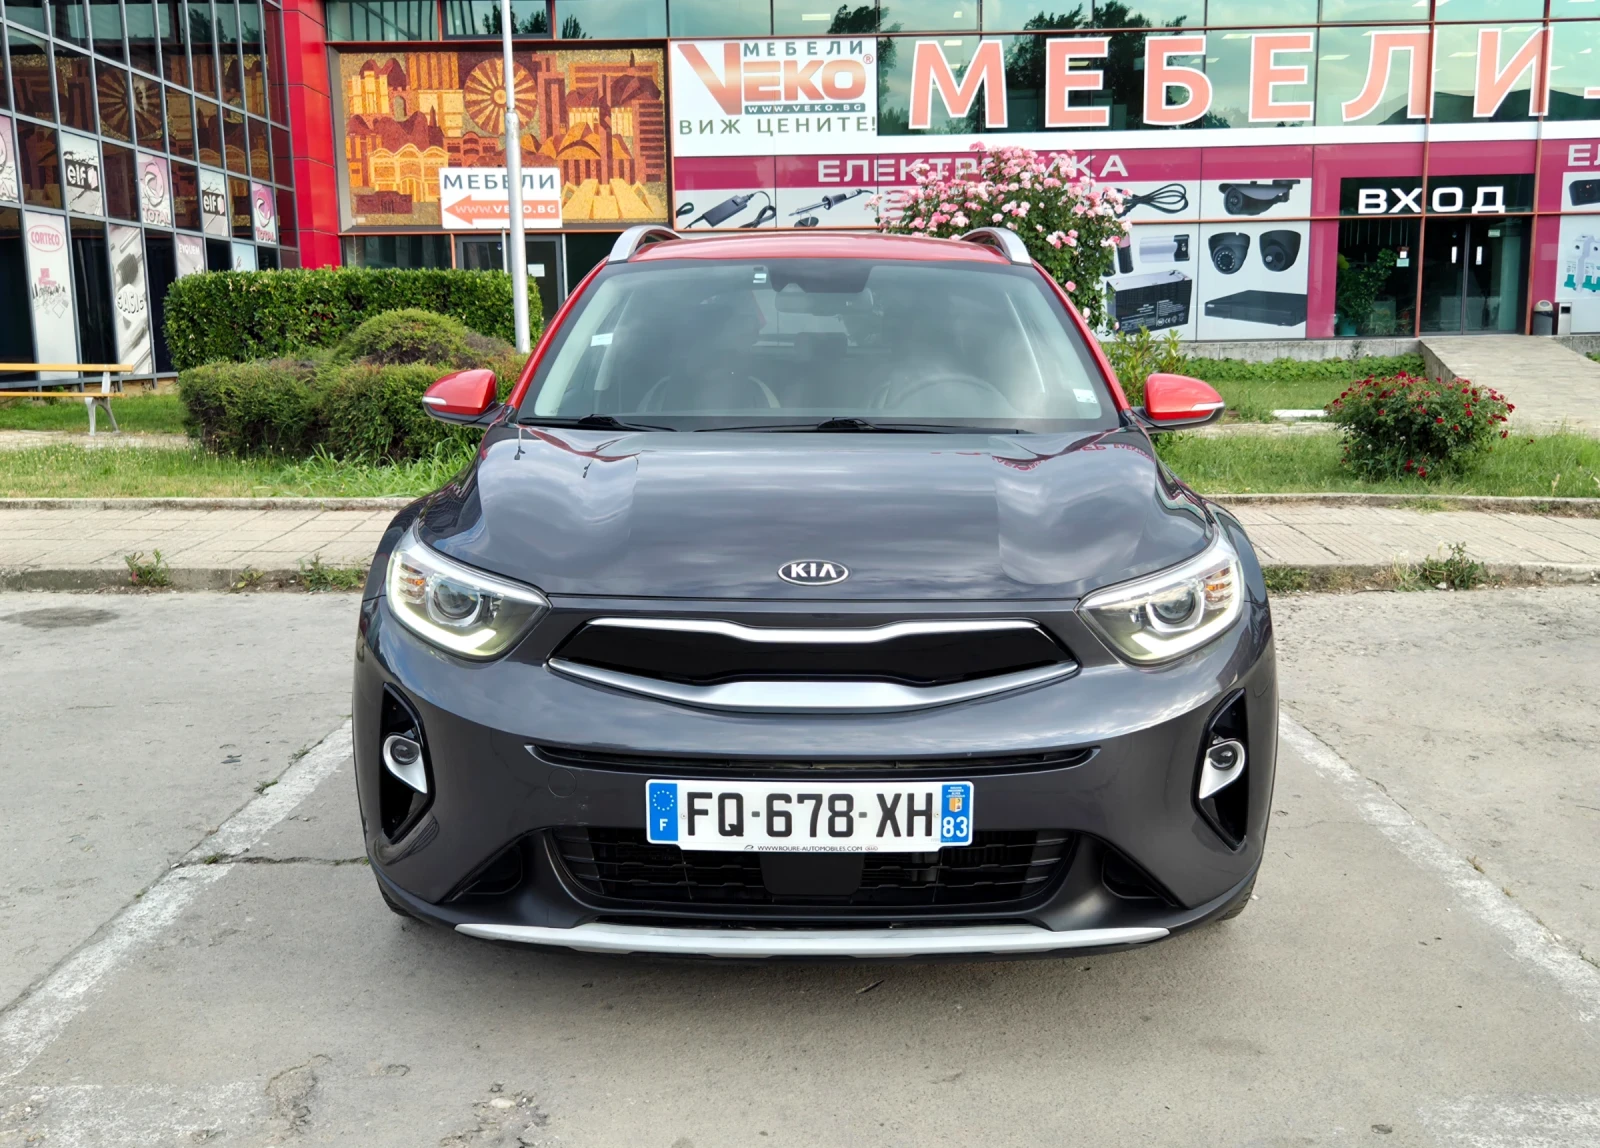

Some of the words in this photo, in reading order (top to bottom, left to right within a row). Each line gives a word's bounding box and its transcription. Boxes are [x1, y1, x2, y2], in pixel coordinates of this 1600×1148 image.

[743, 40, 863, 57] МЕБЕЛИ
[747, 104, 862, 113] WWW.VEKO.BG
[679, 119, 741, 135] ВИЖ
[757, 116, 876, 136] ЦЕНИТЕ!
[66, 163, 86, 186] elf
[817, 154, 1129, 183] ЕЛЕКТРКА
[203, 194, 217, 212] elf
[455, 204, 556, 214] WWW.VEO.BG
[1357, 186, 1506, 214] ВХОД
[142, 207, 171, 225] TOTAL
[30, 231, 60, 246] CORTECO
[255, 227, 276, 243] TOTAL
[790, 562, 838, 578] KIA
[687, 791, 933, 838] FQ-678-XH
[659, 818, 668, 832] F
[942, 816, 968, 838] 83
